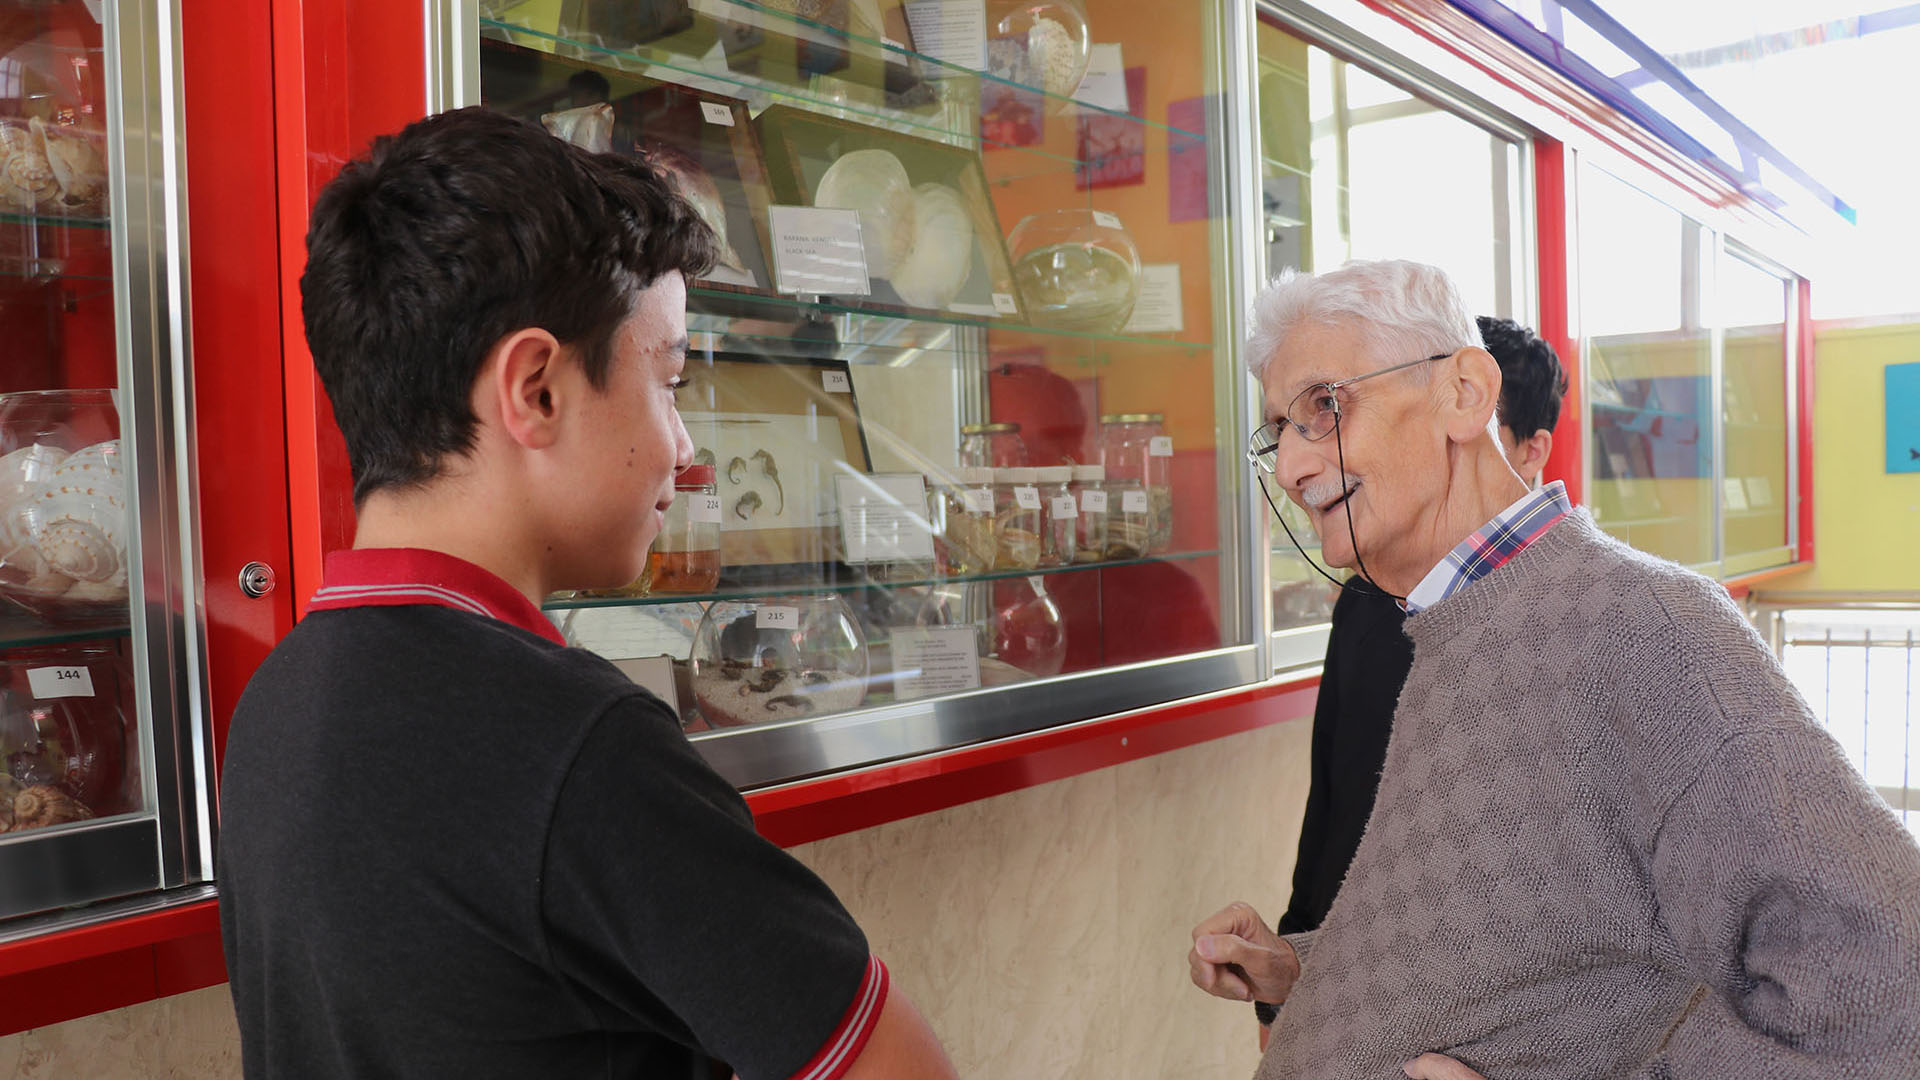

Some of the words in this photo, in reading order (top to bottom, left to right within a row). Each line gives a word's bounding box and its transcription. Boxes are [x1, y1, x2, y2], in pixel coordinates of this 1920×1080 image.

[706, 499, 719, 510] 224
[767, 612, 785, 620] 215
[56, 670, 80, 680] 144
